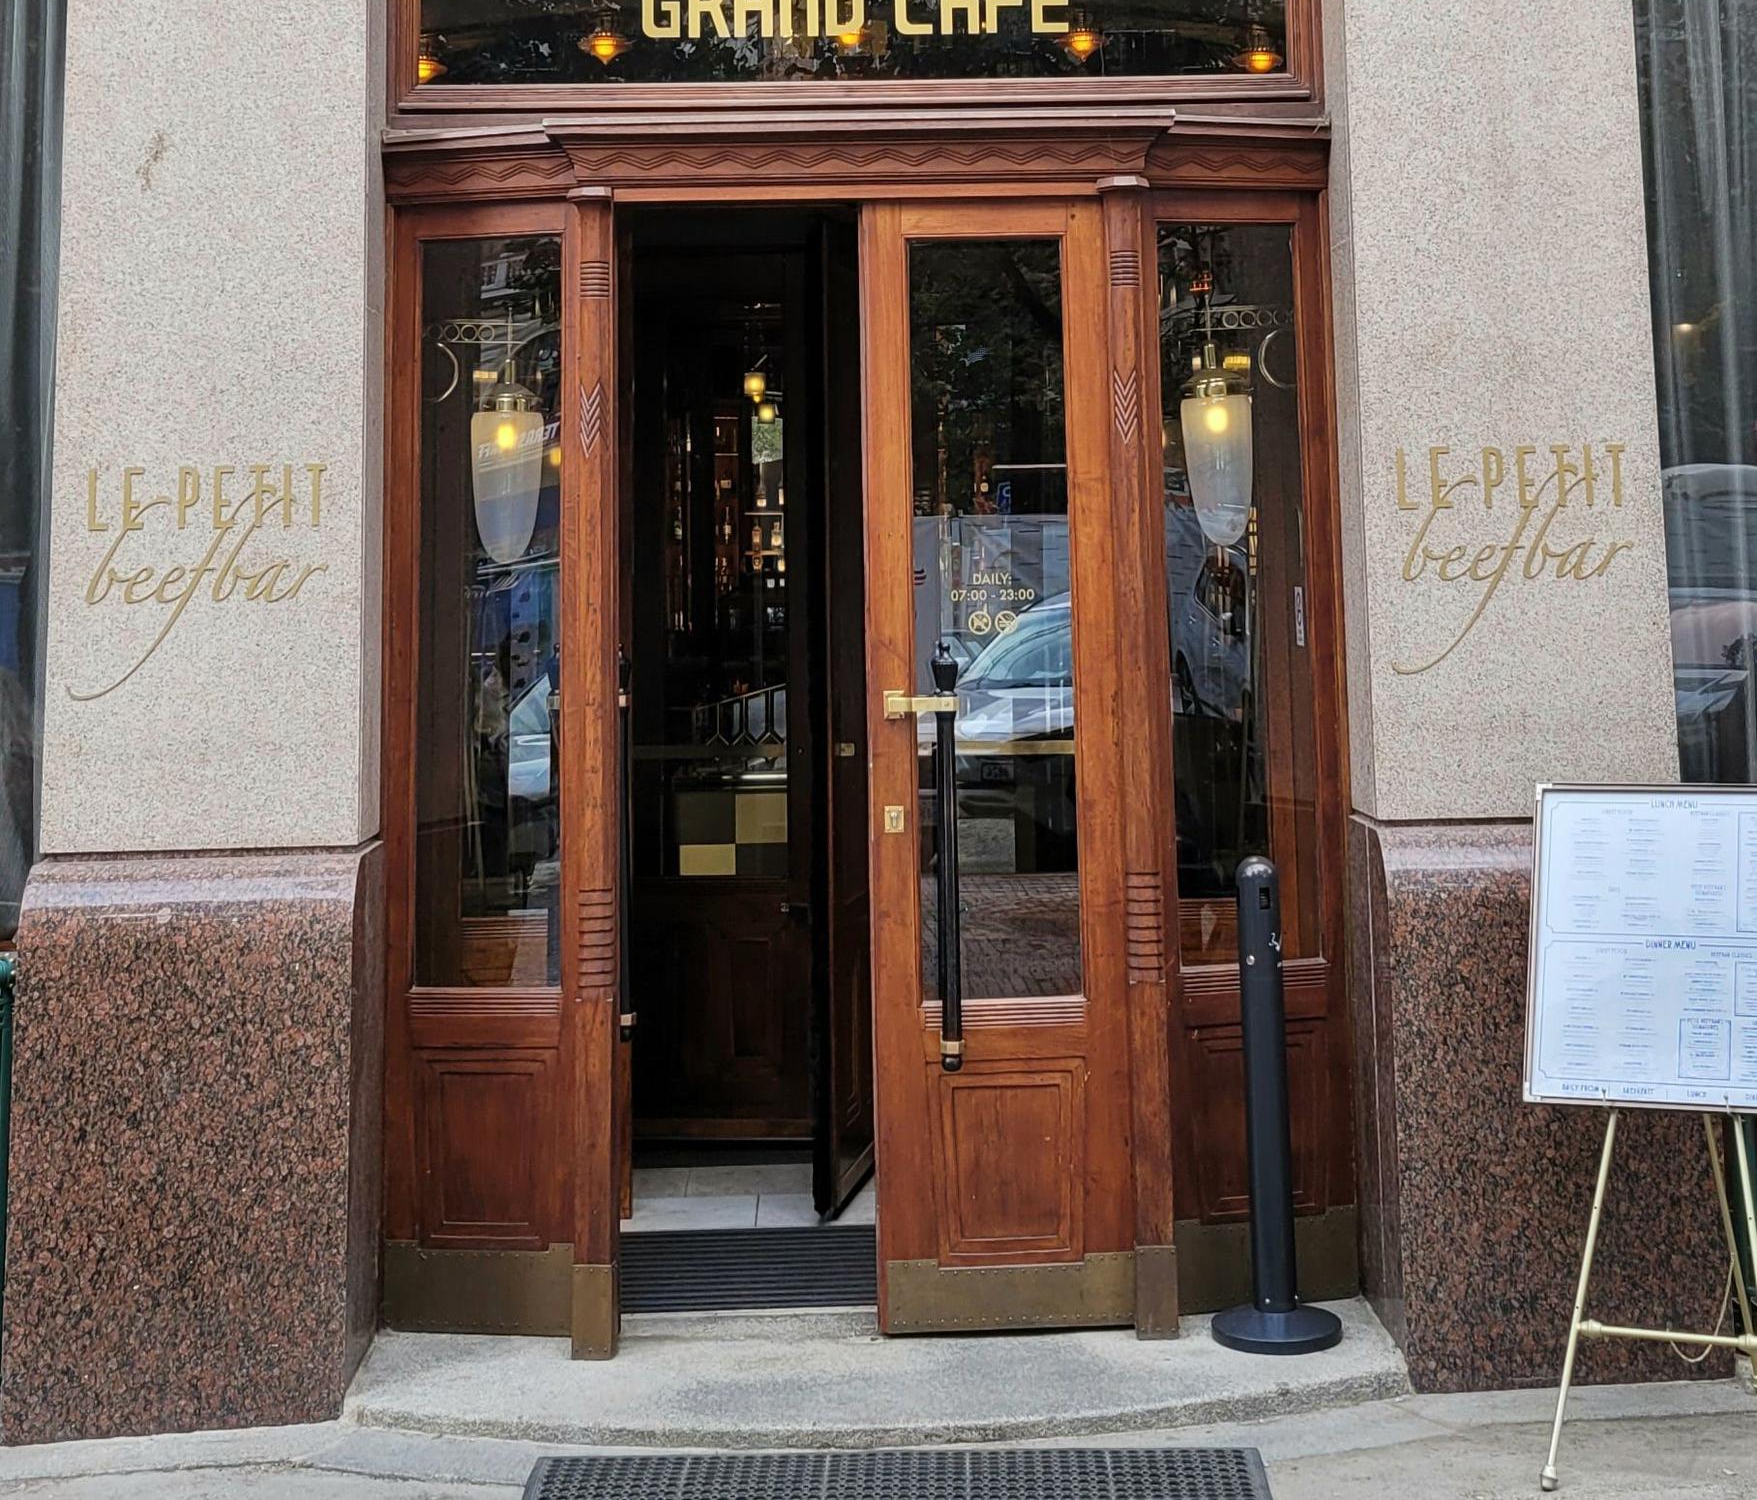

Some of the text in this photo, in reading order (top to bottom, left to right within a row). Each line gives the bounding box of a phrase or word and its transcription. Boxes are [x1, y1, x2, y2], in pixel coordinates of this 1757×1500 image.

[87, 462, 328, 531] LE PETIT
[1395, 442, 1626, 510] LE PETIT
[972, 573, 1013, 585] DAILY:
[1391, 463, 1634, 675] beefbar
[65, 483, 329, 700] beefbar
[950, 590, 987, 602] 07:00
[999, 588, 1035, 600] 23:00
[1650, 800, 1698, 810] LUNCH MENU
[1645, 940, 1697, 950] DINNER MENU
